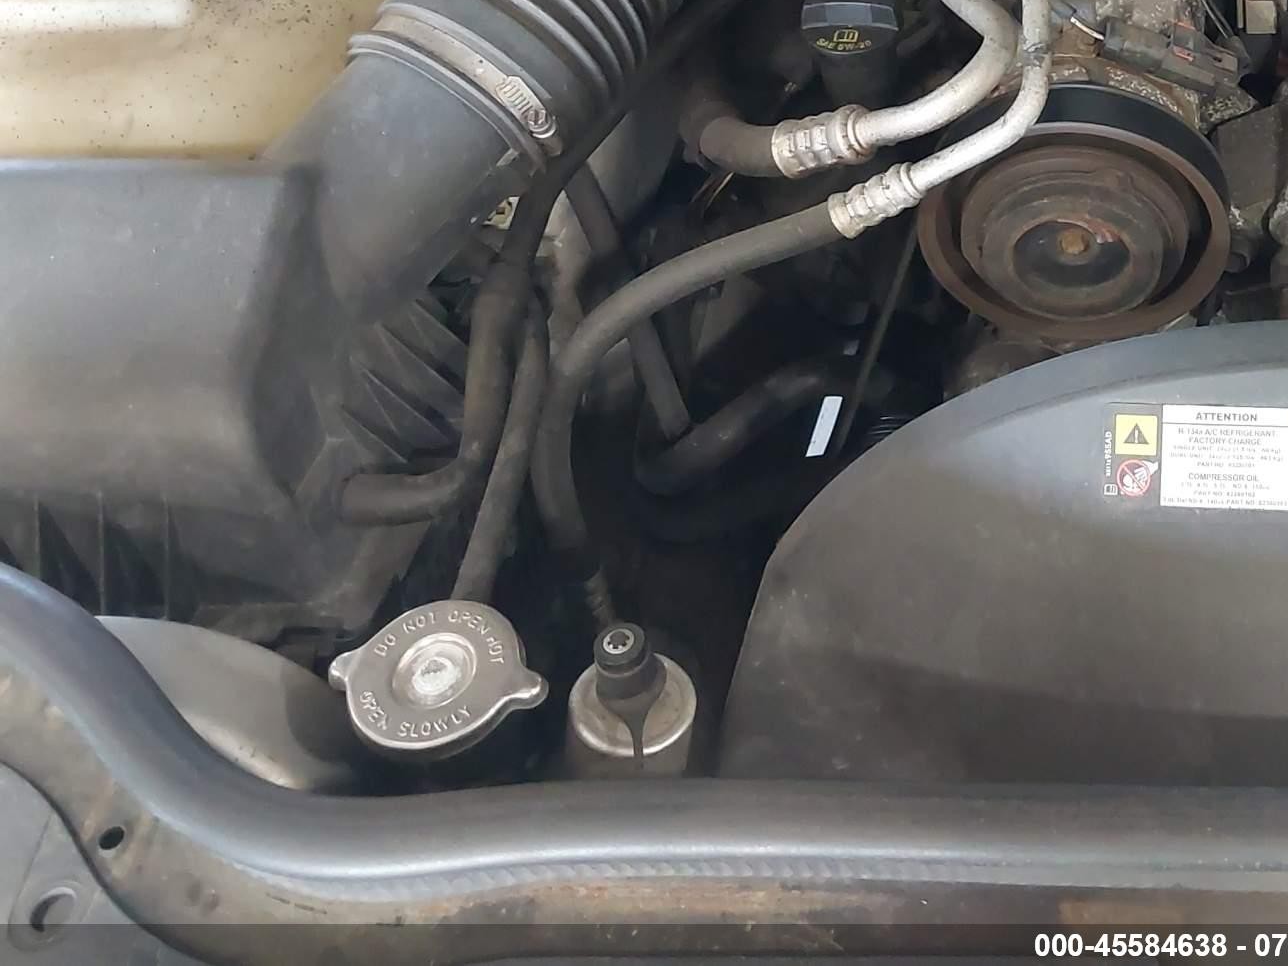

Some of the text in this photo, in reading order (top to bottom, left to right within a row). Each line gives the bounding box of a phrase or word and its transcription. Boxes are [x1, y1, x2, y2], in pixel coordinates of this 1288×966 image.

[1195, 412, 1258, 422] ATTENTION
[1188, 472, 1259, 482] COMPRESSOR OIL
[373, 634, 397, 657] DO
[402, 612, 437, 634] NOT
[448, 610, 491, 635] OPEN
[359, 690, 472, 738] OPEN SLOWLY
